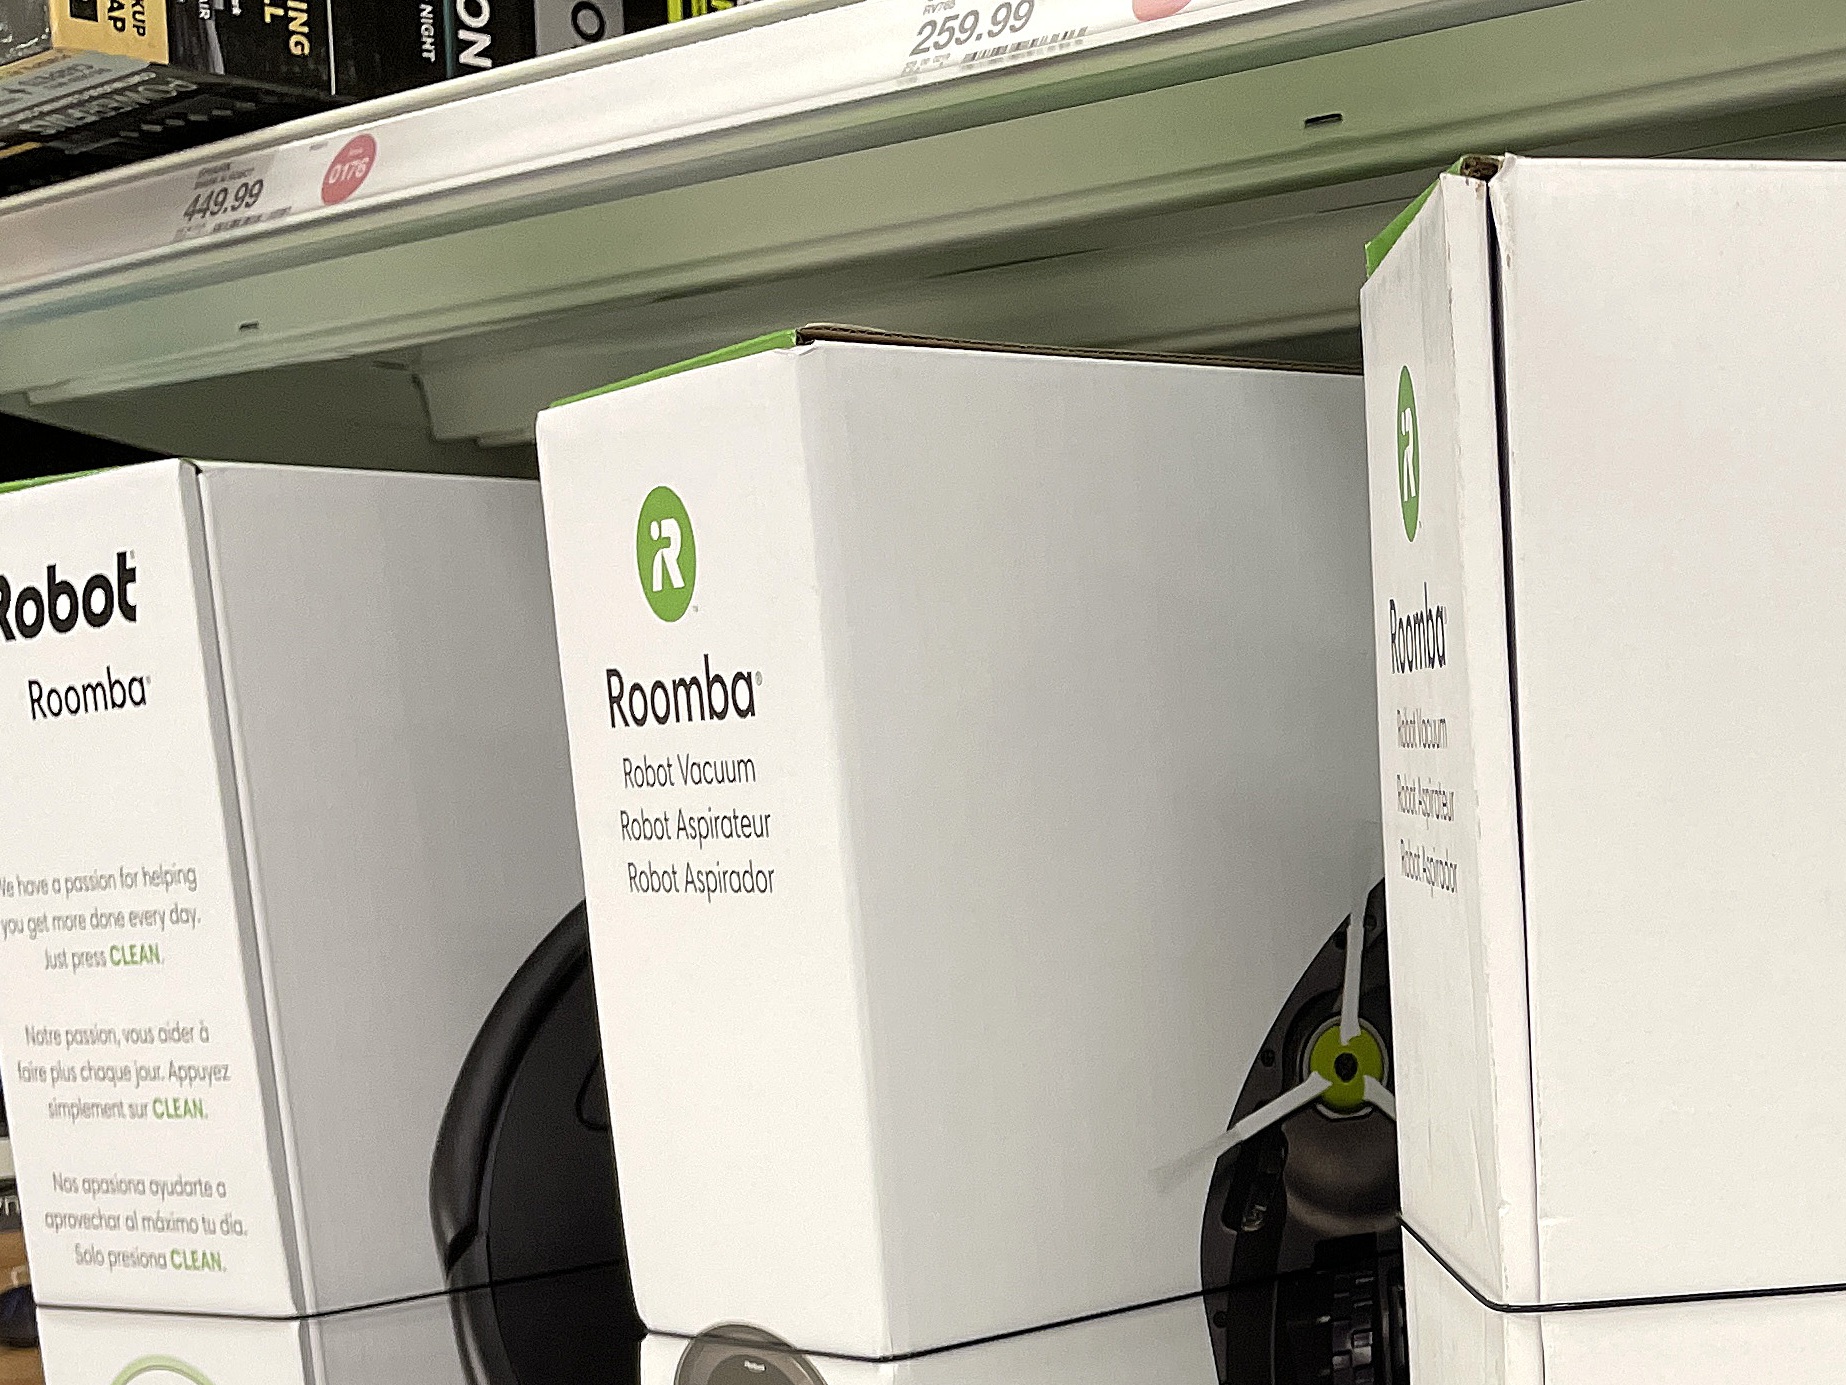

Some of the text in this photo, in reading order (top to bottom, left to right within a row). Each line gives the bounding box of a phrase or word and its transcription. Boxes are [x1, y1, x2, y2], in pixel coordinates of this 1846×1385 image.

[419, 3, 436, 63] NIGHT
[909, 0, 1034, 56] 259.99
[183, 178, 264, 222] 449.99
[1389, 582, 1446, 674] Roomba
[28, 665, 147, 720] Roomba
[606, 653, 756, 729] Roomba
[622, 753, 756, 789] Robot Vacuum
[620, 806, 771, 850] Robot Aspirateur
[16, 874, 49, 896] have
[52, 877, 61, 895] a
[64, 869, 117, 899] passion
[119, 865, 139, 890] for
[141, 863, 198, 893] helping
[627, 859, 775, 904] Robot Aspirador
[0, 917, 24, 941] you
[27, 912, 50, 940] get
[52, 913, 87, 932] more
[90, 907, 125, 930] done
[129, 908, 166, 932] every
[45, 948, 68, 971] Just
[71, 948, 107, 974] press
[25, 1024, 61, 1047] Notre
[66, 1023, 121, 1051] passion,
[123, 1027, 155, 1046] vous
[158, 1021, 194, 1044] aider
[17, 1059, 232, 1089] faire plus chaque jour. Appuyez
[48, 1097, 125, 1124] simplement
[128, 1102, 149, 1119] sur
[52, 1171, 79, 1194] Nos
[82, 1172, 146, 1200] apasiona
[149, 1173, 213, 1202] ayudarte
[44, 1207, 121, 1233] aprovechar
[125, 1209, 139, 1232] al
[142, 1209, 199, 1234] máximo
[202, 1213, 216, 1235] tu
[74, 1242, 104, 1267] Solo
[107, 1246, 168, 1273] presiona
